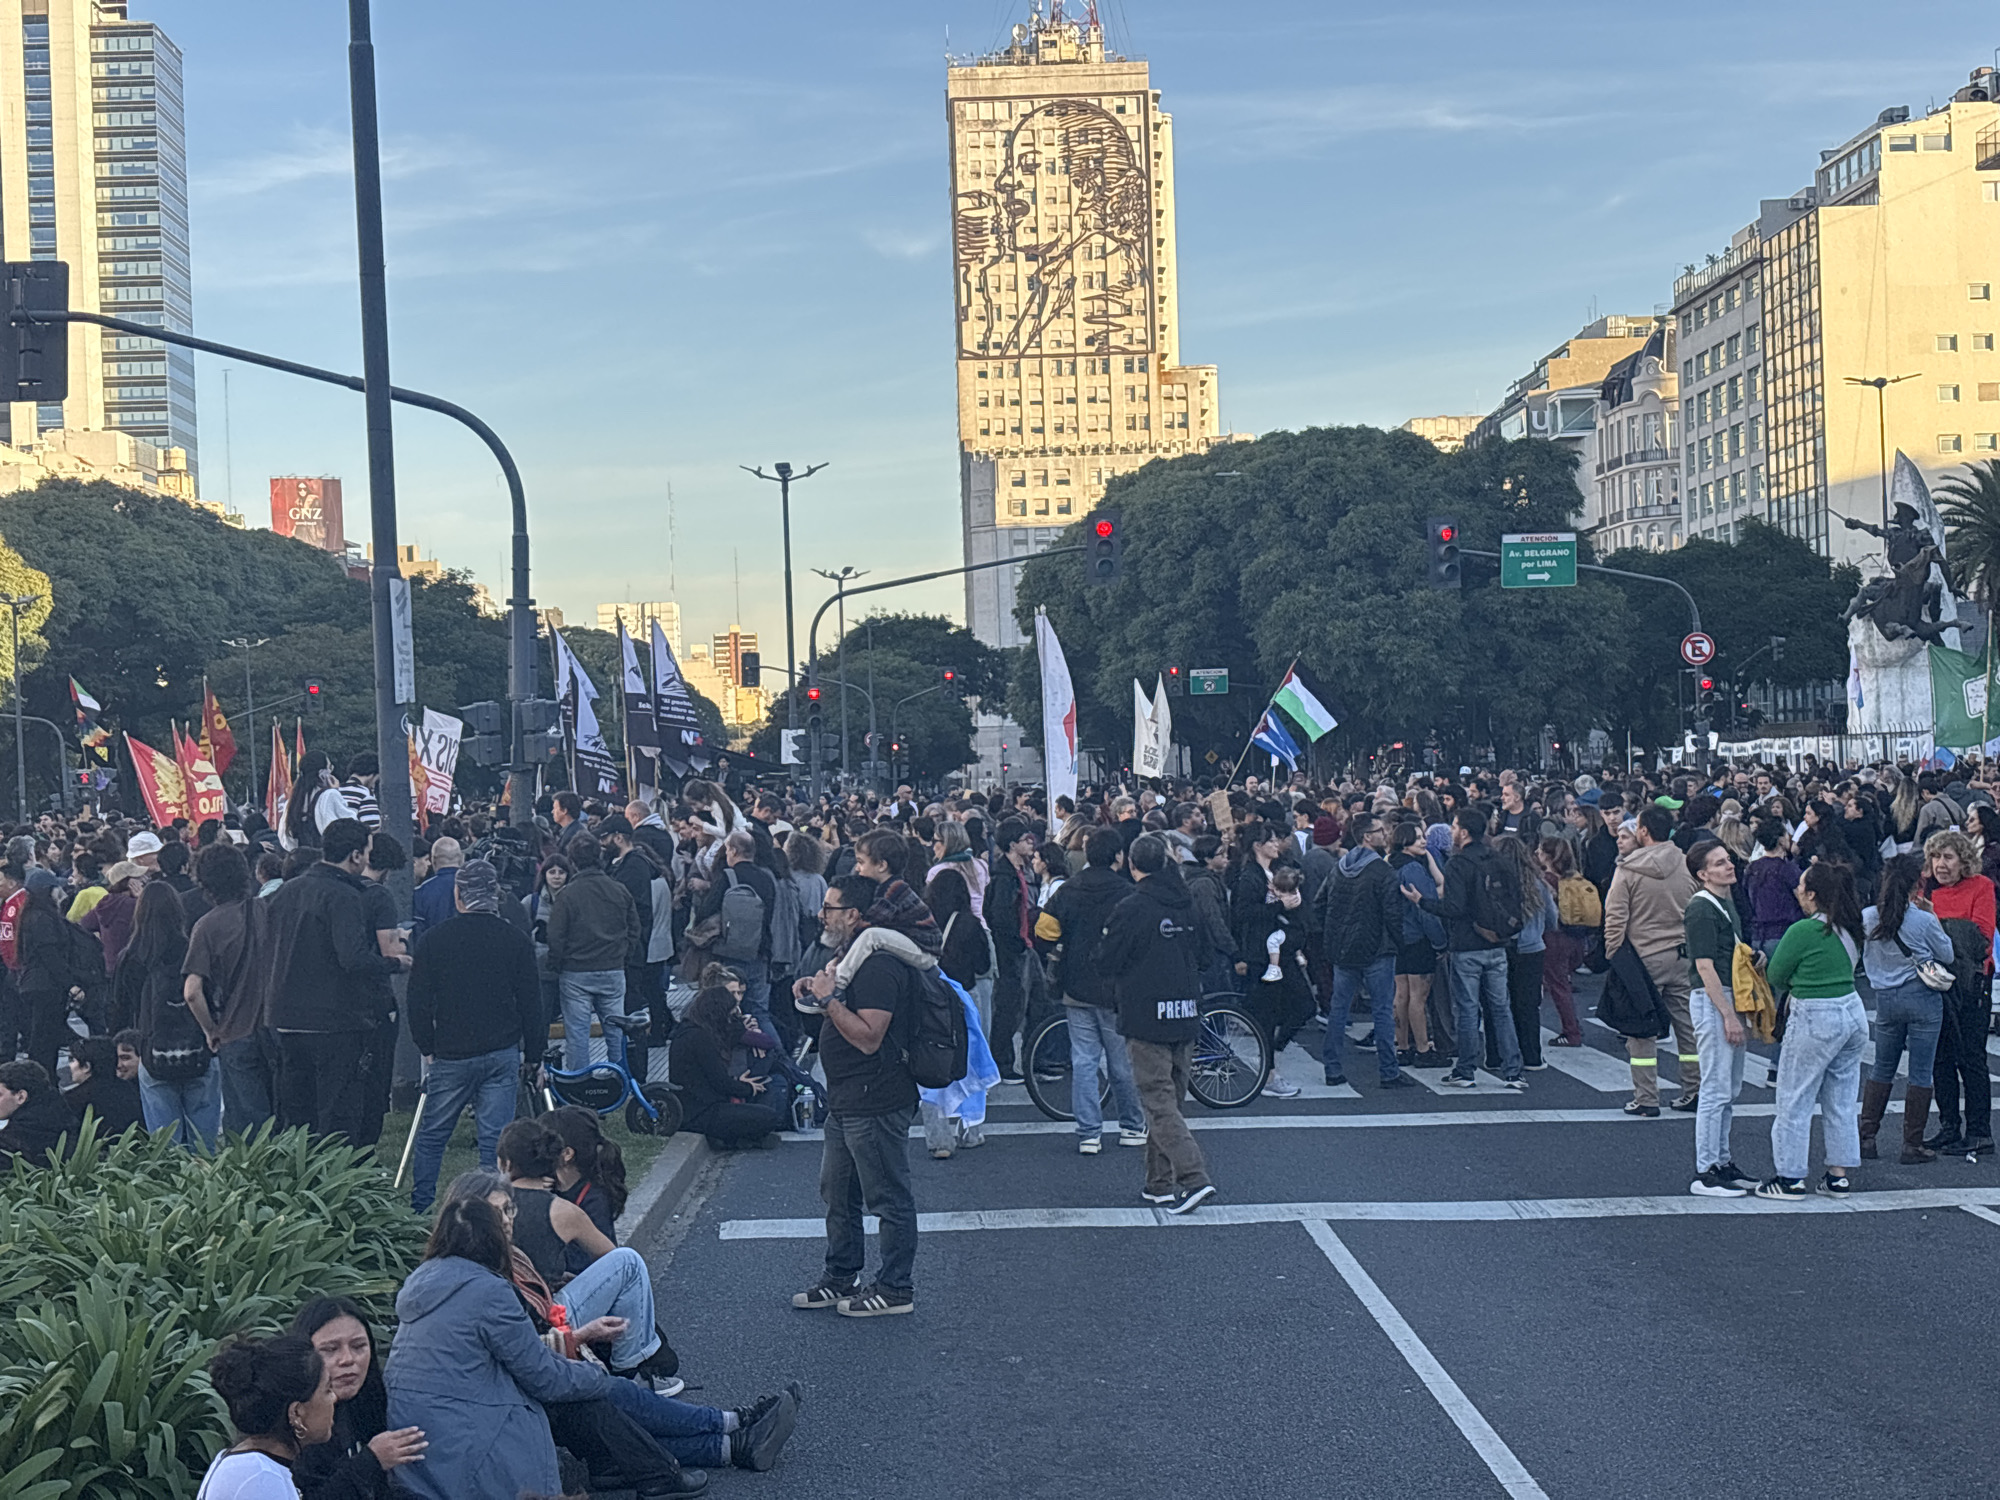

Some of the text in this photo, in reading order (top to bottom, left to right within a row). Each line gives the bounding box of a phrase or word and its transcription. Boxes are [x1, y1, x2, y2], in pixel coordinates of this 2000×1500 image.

[288, 508, 323, 519] GNZ
[1524, 549, 1570, 557] BELGRANO
[1521, 561, 1535, 569] por
[1691, 640, 1705, 657] E
